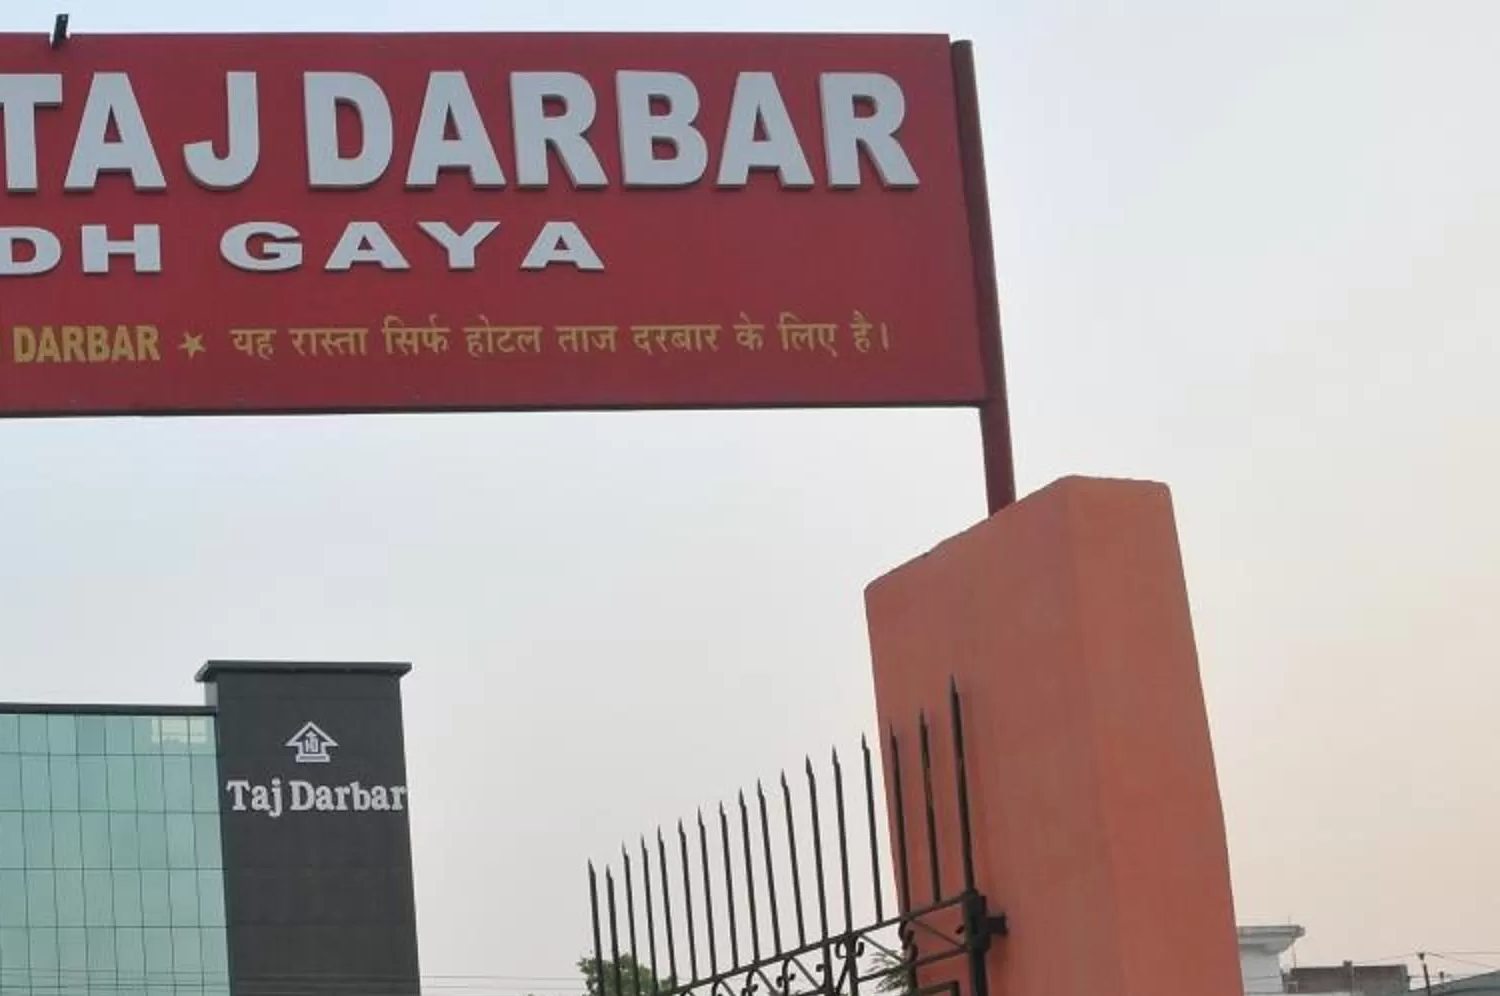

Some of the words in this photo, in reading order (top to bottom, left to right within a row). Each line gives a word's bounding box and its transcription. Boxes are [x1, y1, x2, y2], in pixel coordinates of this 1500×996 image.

[303, 69, 920, 191] DARBAR
[219, 220, 605, 272] GAYA
[12, 324, 161, 364] DARBAR
[229, 327, 278, 360] यह
[288, 327, 369, 356] रास्ता
[380, 313, 451, 356] सिर्फ
[462, 314, 544, 357] होटल
[555, 325, 619, 353] ताज
[629, 324, 722, 356] दरबार
[732, 311, 765, 352] के
[776, 312, 839, 358] लिए
[226, 777, 283, 817] Taj
[288, 780, 407, 811] Darbar
